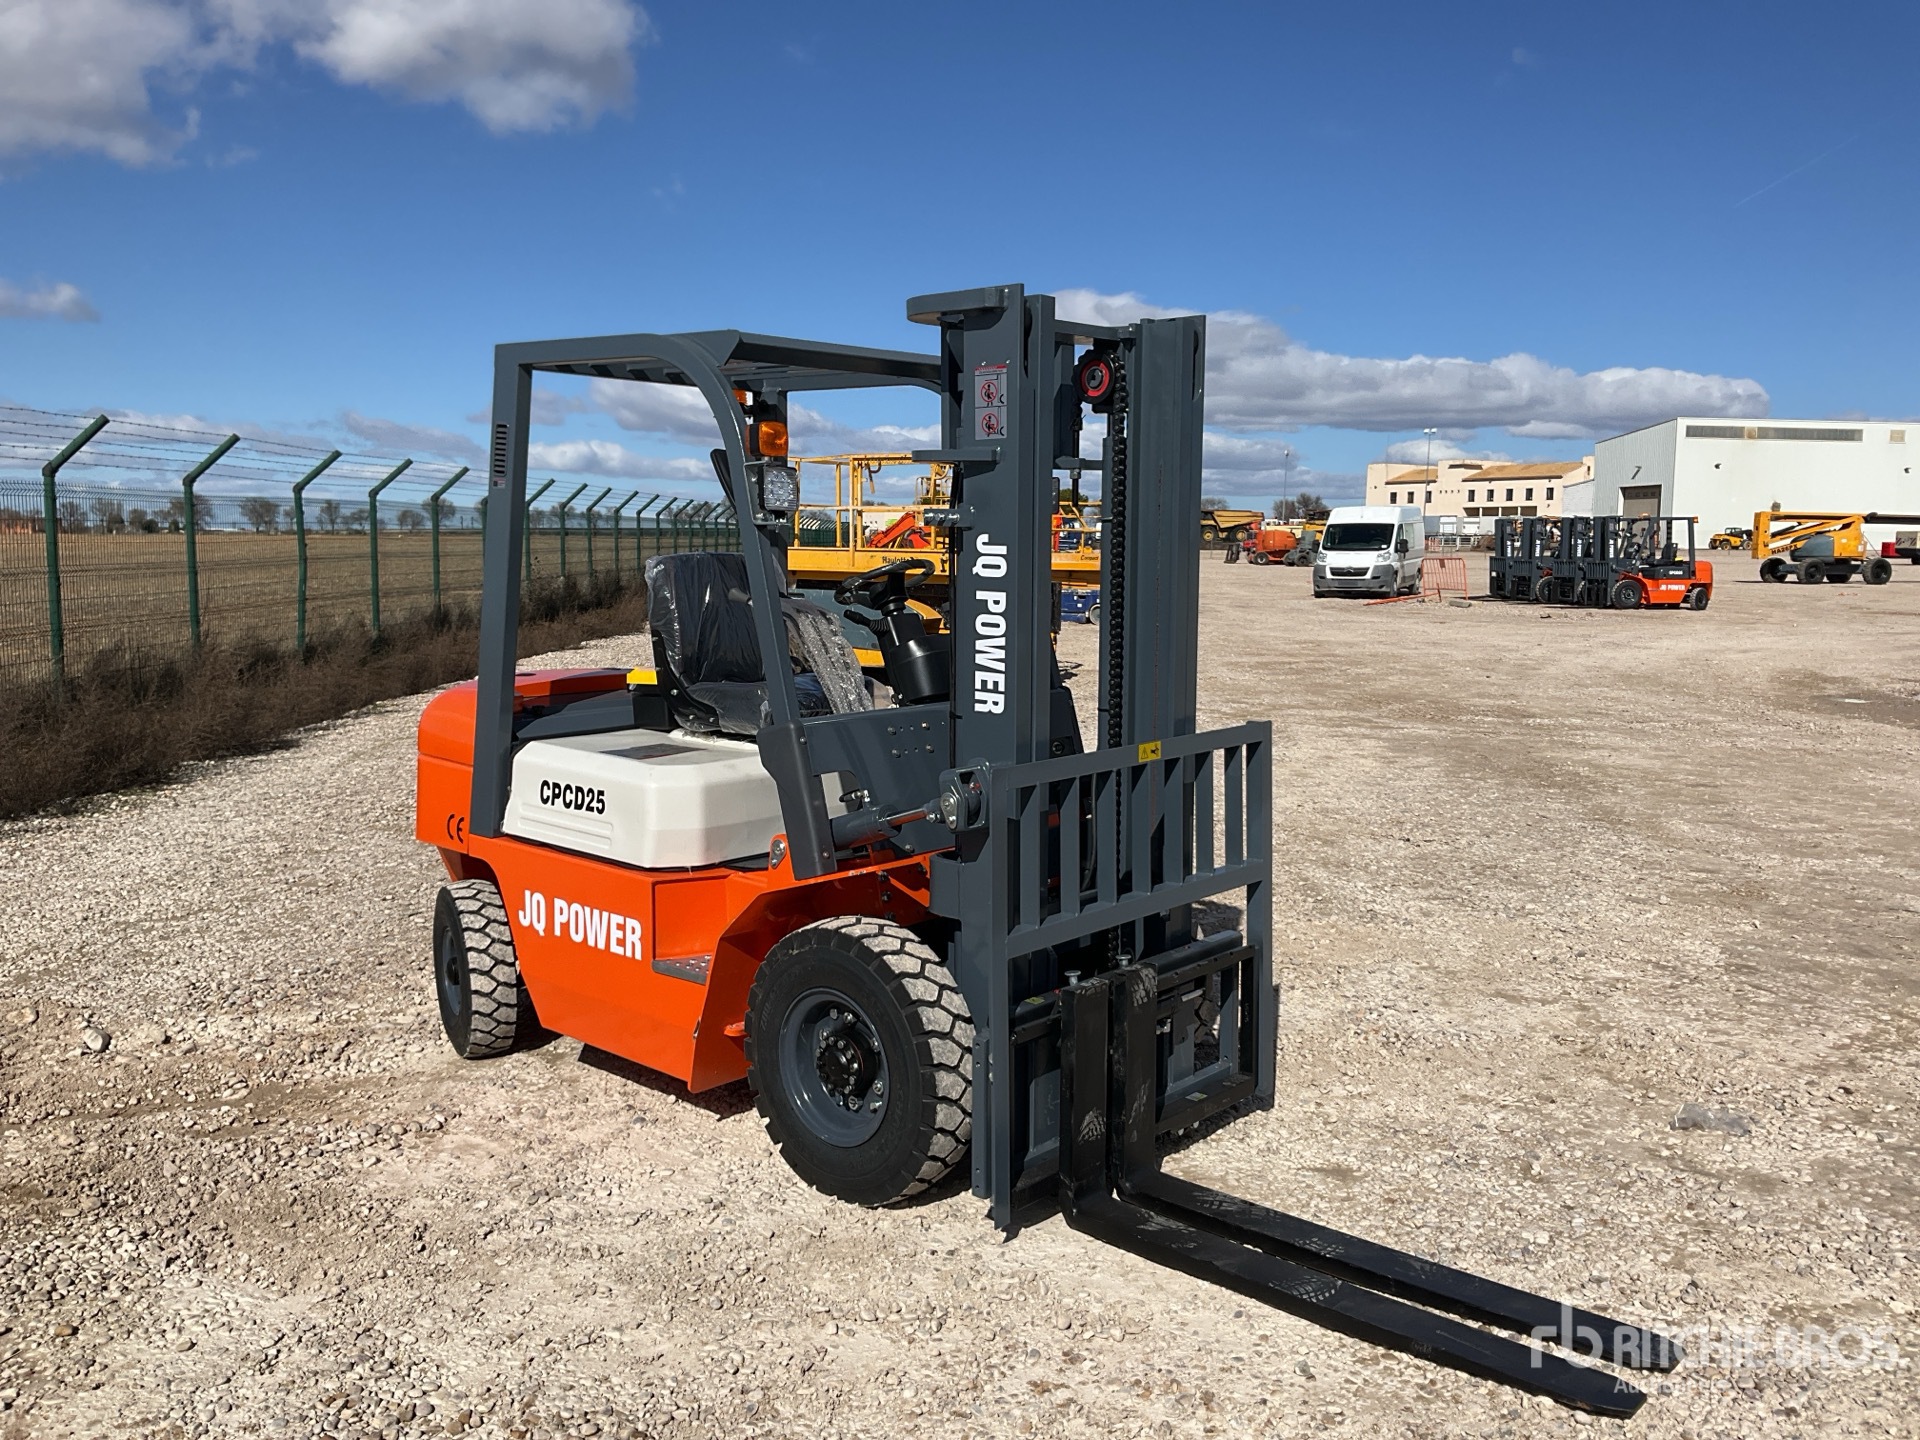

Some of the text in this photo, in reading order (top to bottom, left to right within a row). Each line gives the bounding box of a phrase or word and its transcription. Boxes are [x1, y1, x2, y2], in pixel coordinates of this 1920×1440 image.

[1631, 466, 1642, 480] 7
[973, 534, 1007, 714] JQ POWER
[540, 779, 606, 815] CPCD25
[518, 889, 642, 961] JQ POWER
